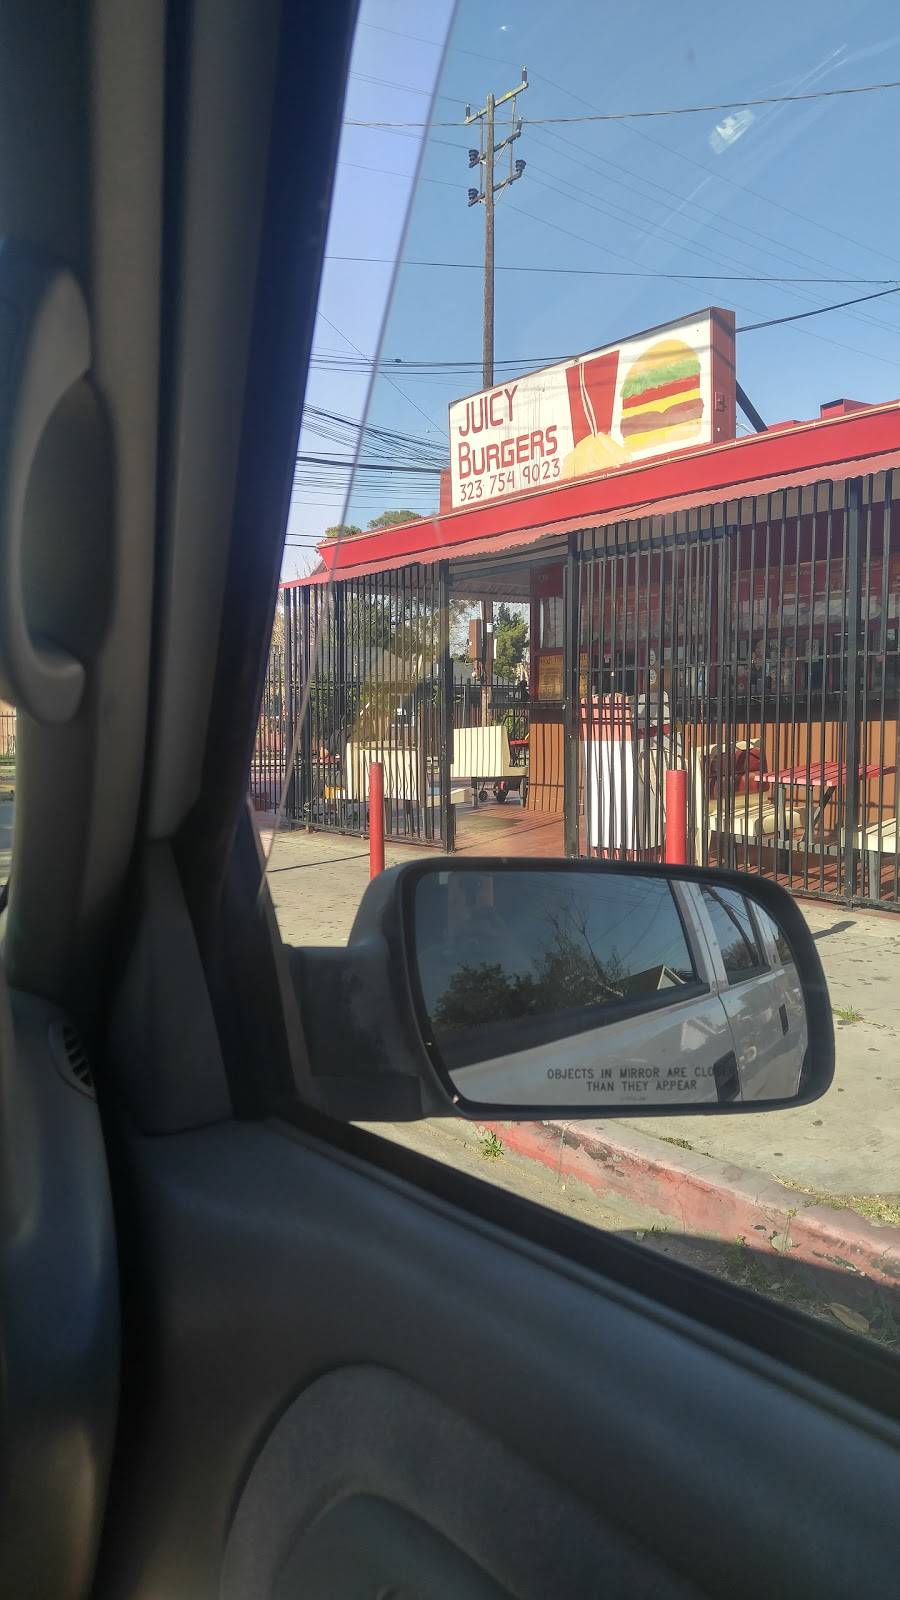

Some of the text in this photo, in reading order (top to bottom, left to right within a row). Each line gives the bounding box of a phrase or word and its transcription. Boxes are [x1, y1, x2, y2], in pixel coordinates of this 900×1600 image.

[458, 384, 518, 437] JUICY
[458, 425, 557, 480] BURGERS
[460, 458, 560, 502] 323 754 9023
[547, 1067, 738, 1080] OBJECTS IN MIRROR ARE CLO
[587, 1080, 697, 1092] THAN THEY APPEAR
